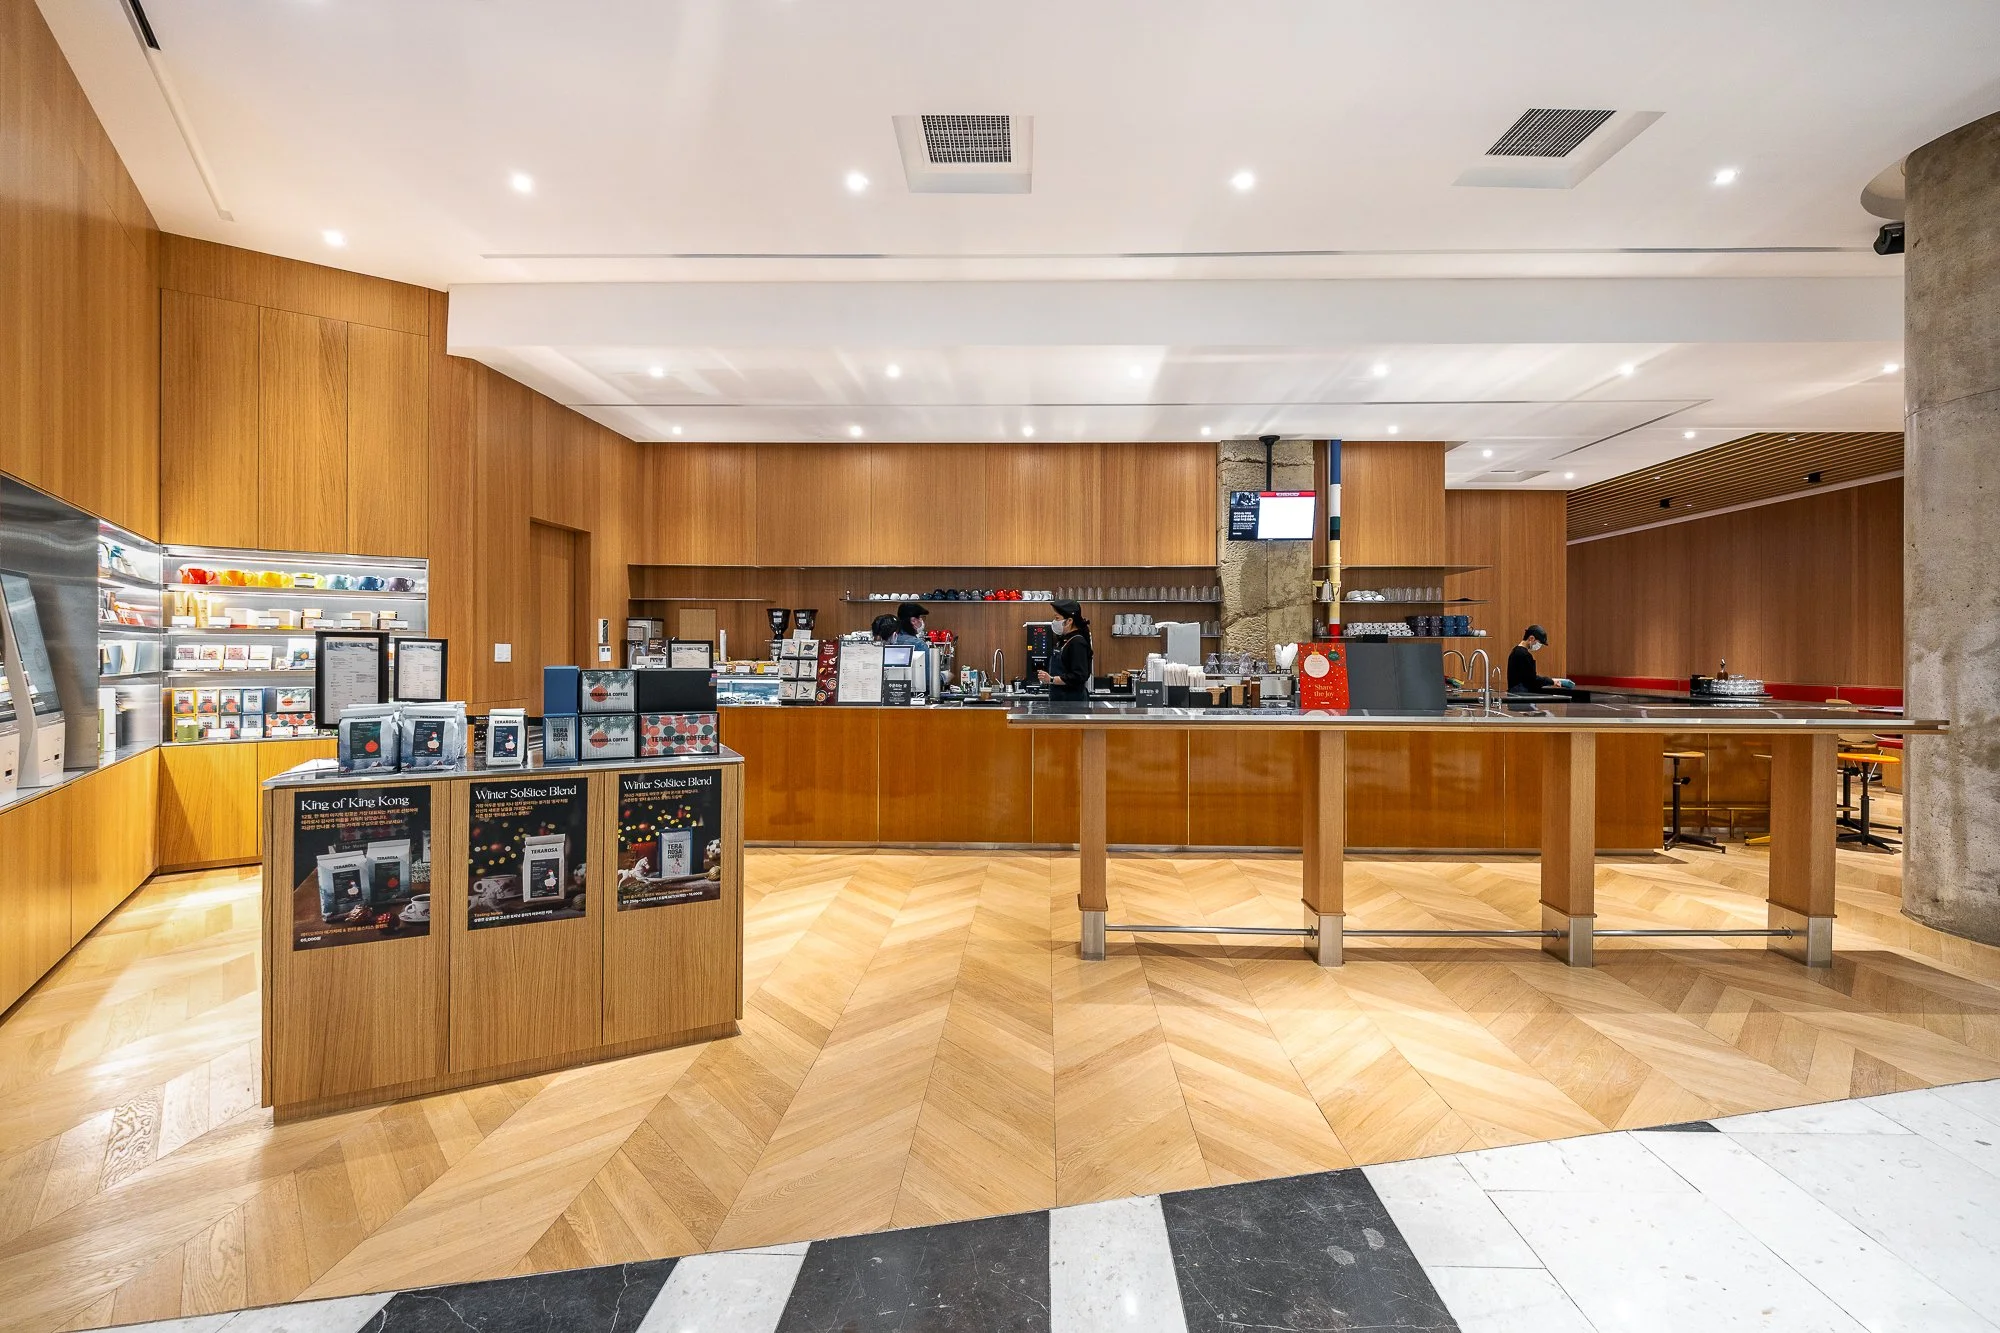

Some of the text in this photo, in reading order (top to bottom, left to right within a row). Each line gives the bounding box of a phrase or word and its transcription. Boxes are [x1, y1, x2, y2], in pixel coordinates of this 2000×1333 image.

[624, 776, 712, 790] Winter Solstice Blend
[476, 785, 577, 800] Winter Solstice Blend
[301, 796, 410, 810] King of King Kong
